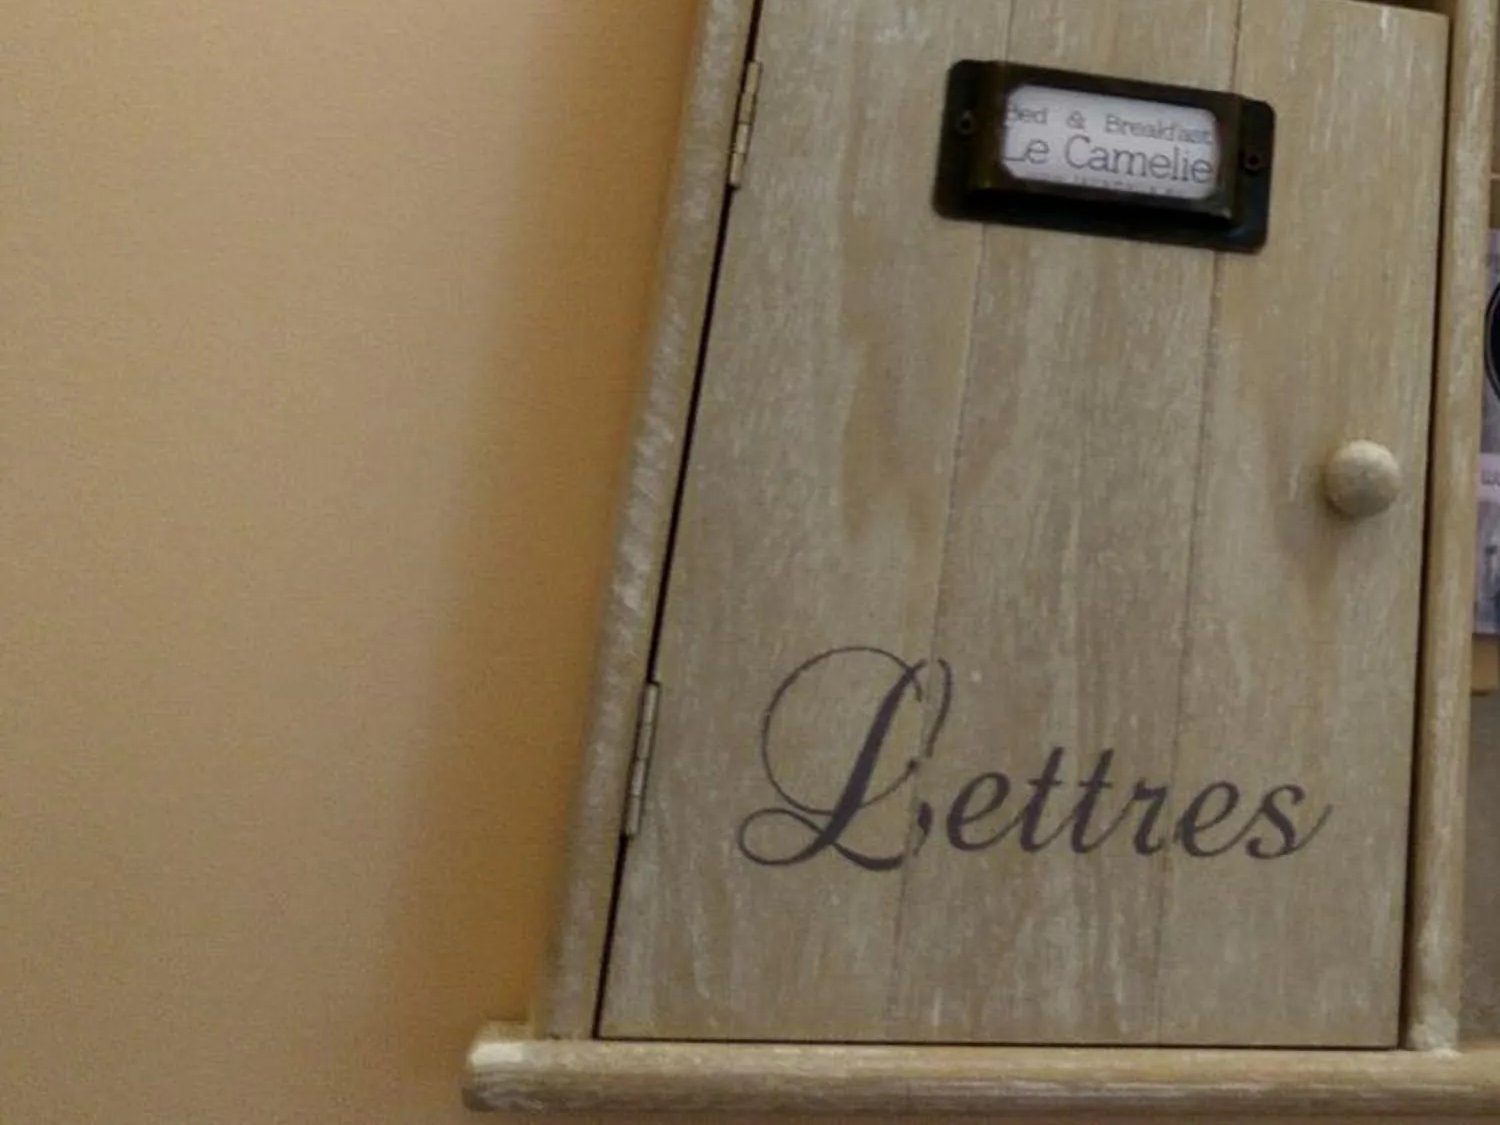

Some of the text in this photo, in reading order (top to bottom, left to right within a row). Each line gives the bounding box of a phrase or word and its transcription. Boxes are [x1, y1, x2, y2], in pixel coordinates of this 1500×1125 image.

[1066, 110, 1086, 130] &
[1064, 134, 1214, 184] Camelie
[737, 646, 1335, 872] Lettres
